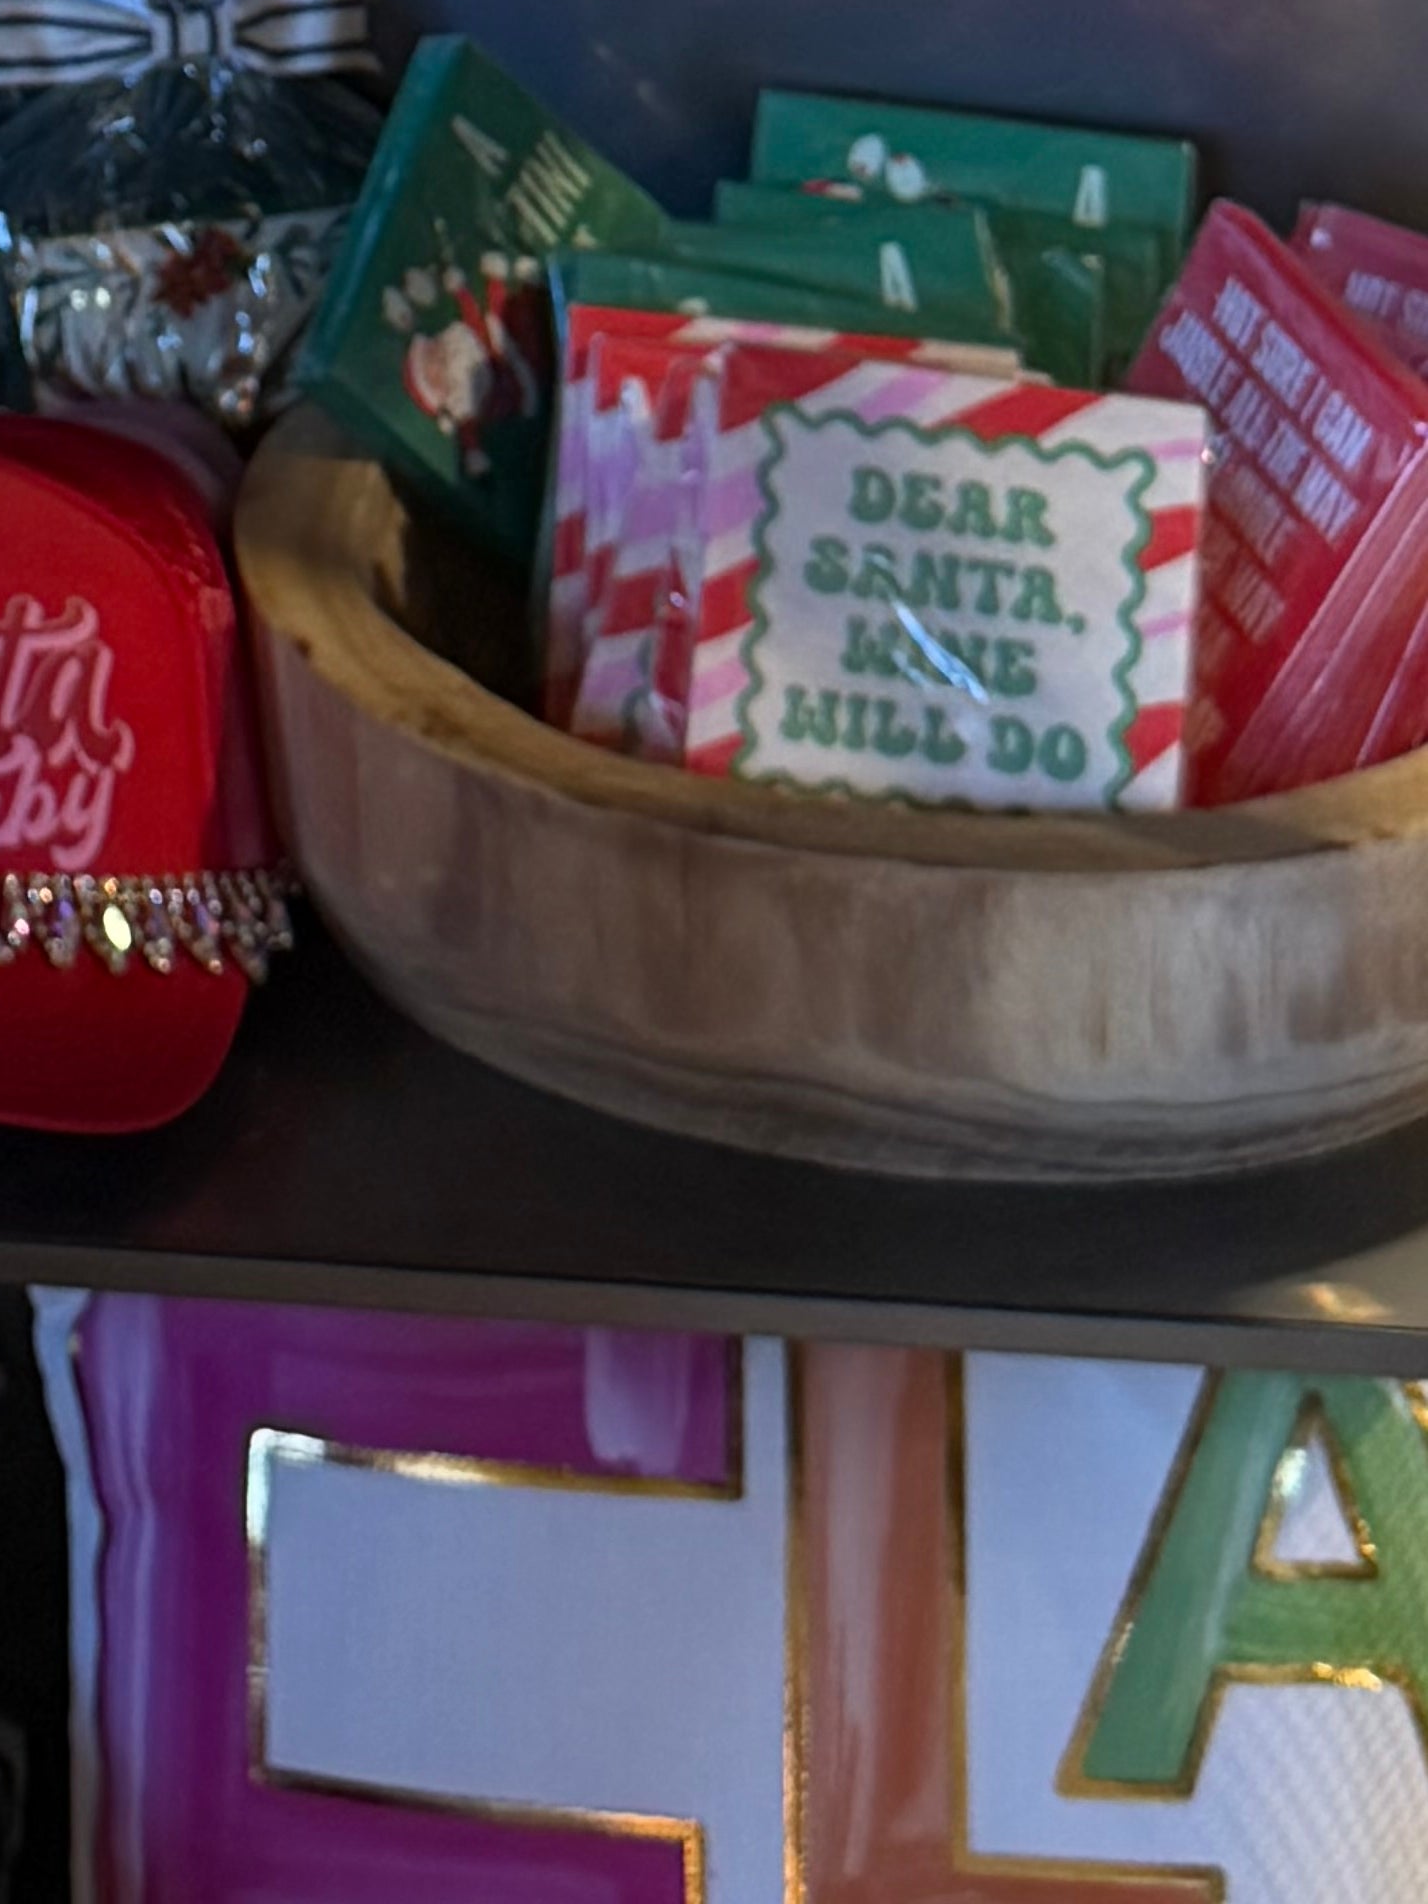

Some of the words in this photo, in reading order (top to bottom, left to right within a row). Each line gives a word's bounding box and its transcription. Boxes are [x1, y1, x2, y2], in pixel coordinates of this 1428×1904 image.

[1250, 319, 1316, 410] SURE
[1298, 374, 1329, 424] I
[1312, 390, 1374, 472] CAN
[849, 464, 1055, 547] DEAR
[1291, 454, 1363, 548] WAY
[803, 535, 1086, 635] SANTA,
[779, 685, 967, 764] WILL
[986, 714, 1088, 782] DO
